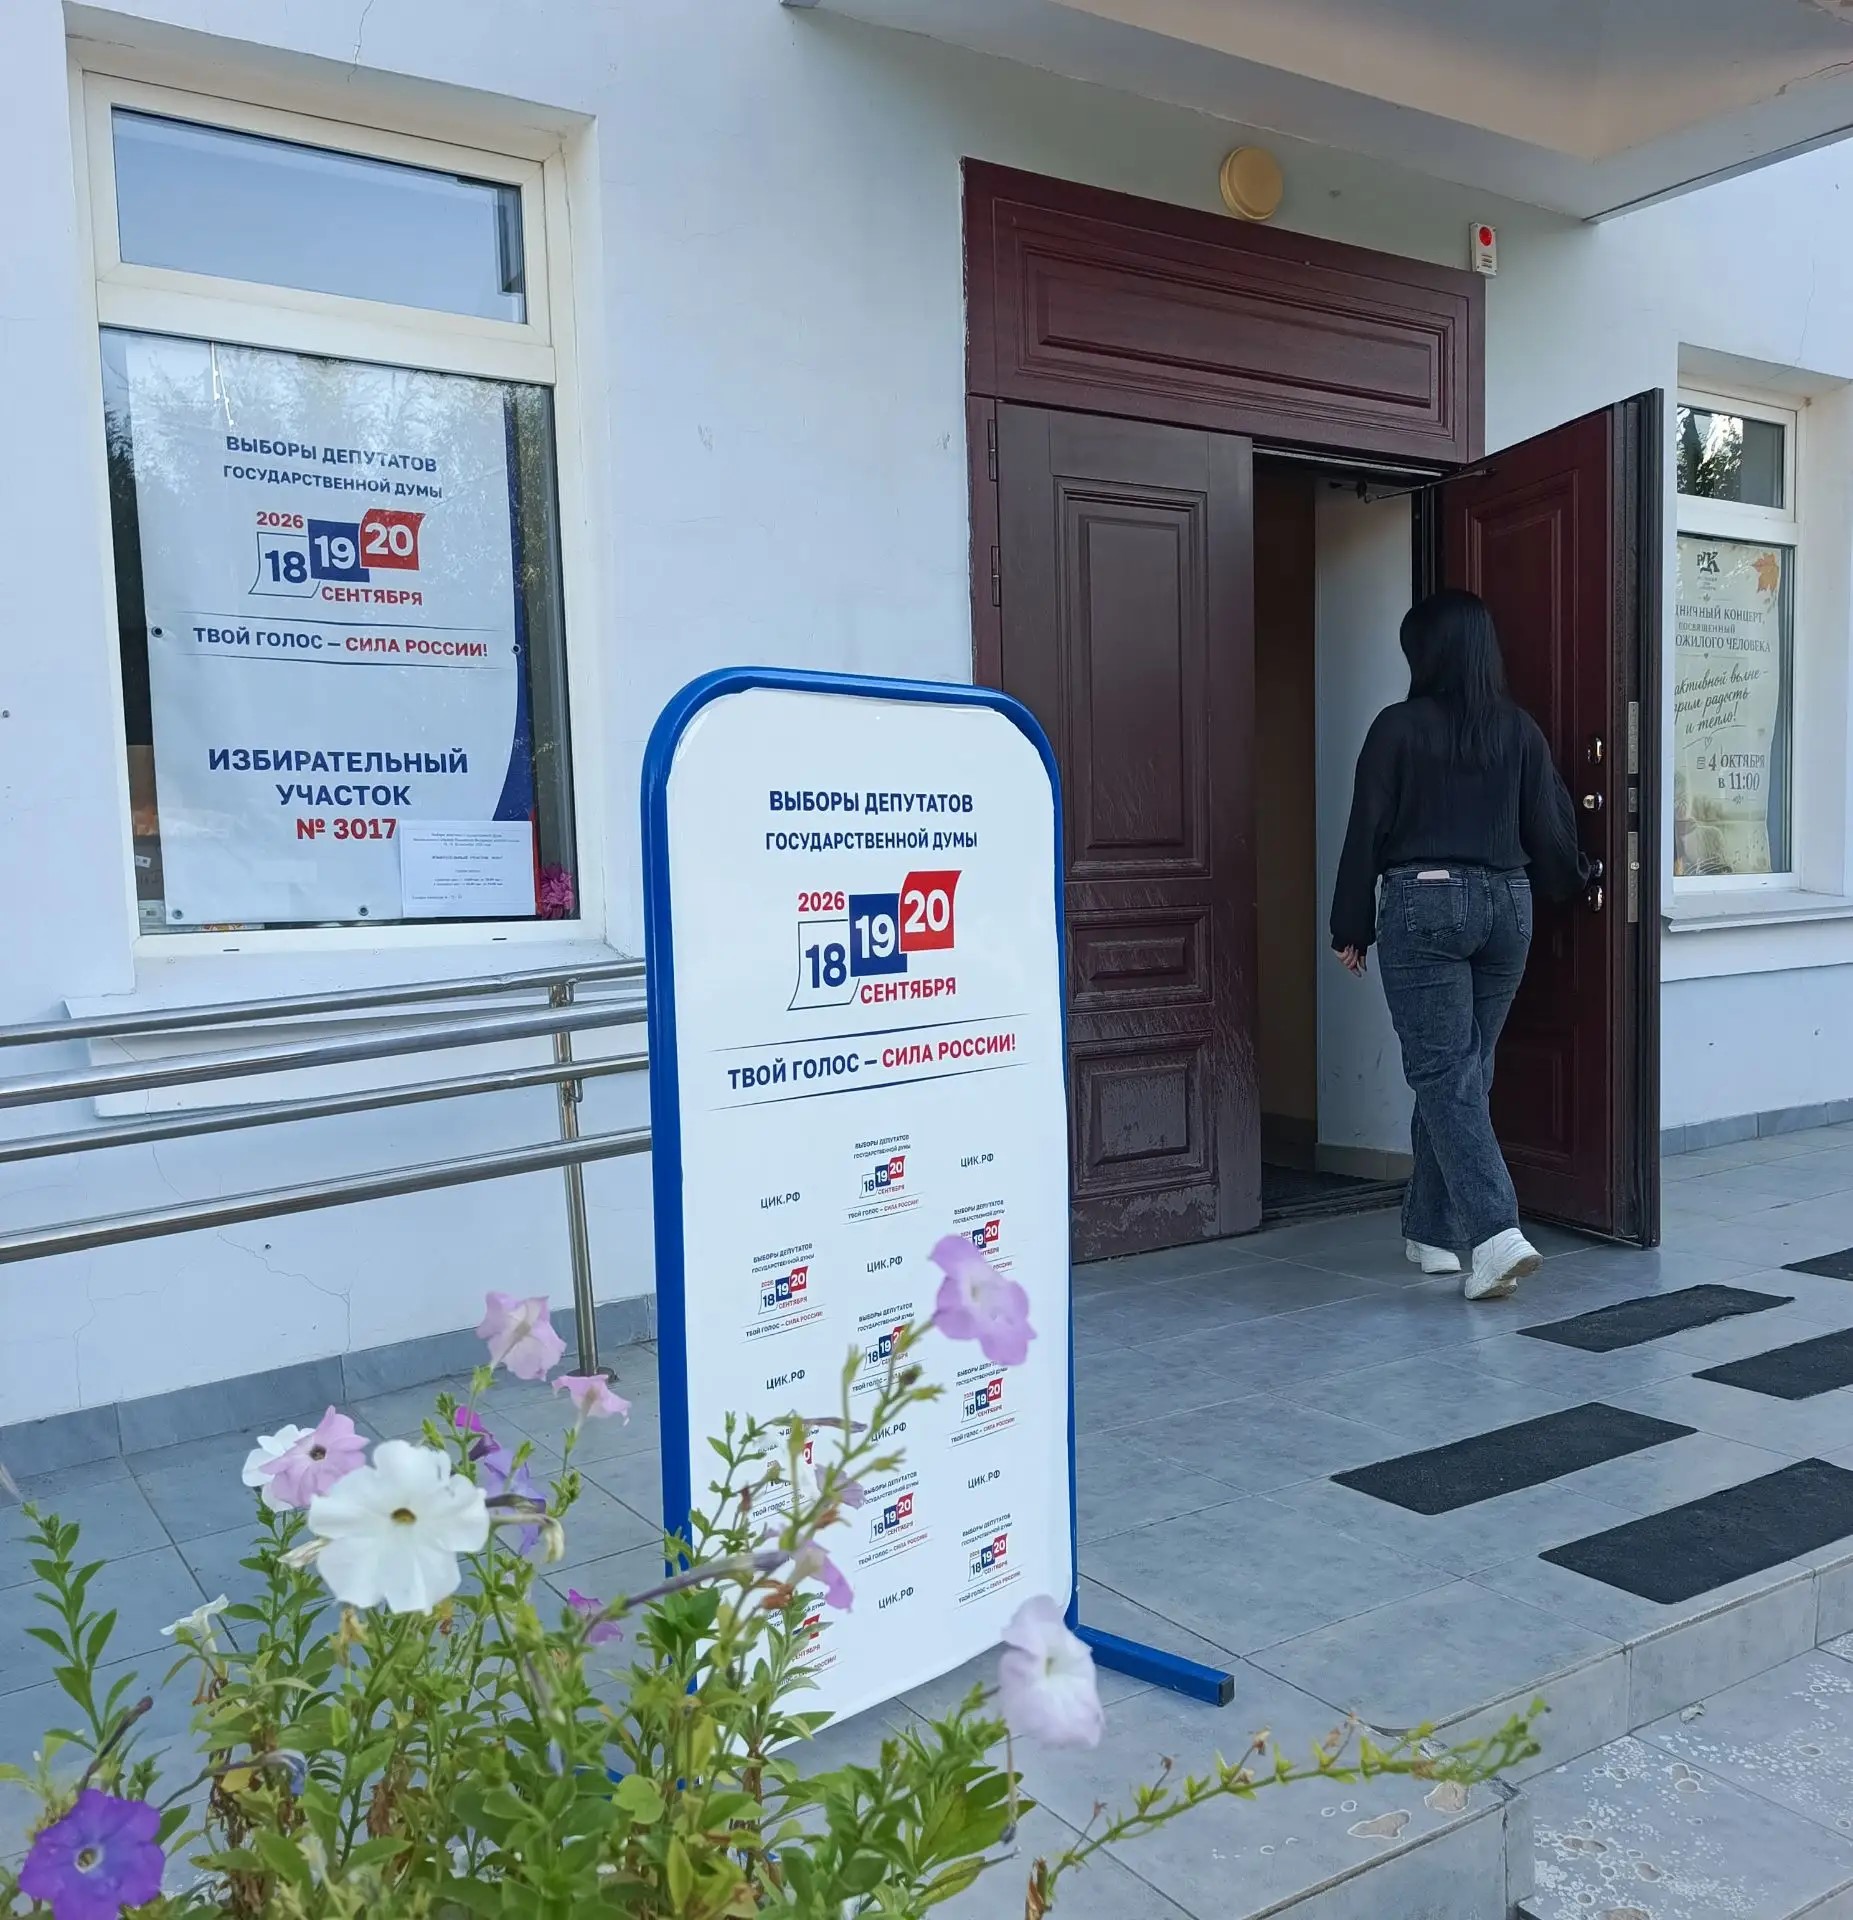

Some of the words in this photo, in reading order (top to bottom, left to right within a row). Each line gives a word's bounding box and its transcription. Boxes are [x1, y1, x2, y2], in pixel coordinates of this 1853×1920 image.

[226, 436, 317, 461] ВЫБОРЫ
[322, 447, 437, 473] ДЕПУТАТОВ
[223, 465, 390, 493] ГОСУДАРСТВЕННОЙ
[394, 480, 442, 499] ДУМЫ
[256, 511, 304, 529] 2026
[264, 550, 307, 583] 18
[314, 535, 354, 569] 19
[365, 523, 414, 555] 20
[321, 586, 423, 607] СЕНТЯБРЯ
[193, 624, 251, 645] ТВОЙ
[256, 631, 323, 649] ГОЛОС
[345, 636, 399, 654] СИЛА
[406, 639, 488, 657] РОССИИ!
[1726, 637, 1770, 652] ЧЕЛОВЕКА
[209, 746, 468, 772] ИЗБИРАТЕЛЬНЫЙ
[1709, 753, 1716, 771] 4
[1720, 754, 1765, 768] ОКТЯБРЯ
[1729, 772, 1759, 790] 11:00
[276, 785, 411, 806] УЧАСТОК
[769, 790, 859, 812] ВЫБОРЫ
[865, 793, 973, 815] ДЕПУТАТОВ
[297, 819, 325, 839] №
[333, 819, 397, 839] 3017
[766, 827, 928, 852] ГОСУДАРСТВЕННОЙ
[933, 831, 977, 850] ДУМЫ
[798, 891, 845, 912] 2026
[805, 943, 847, 988] 18
[855, 914, 896, 958] 19
[904, 889, 950, 933] 20
[860, 977, 956, 1004] СЕНТЯБРЯ
[728, 1058, 787, 1090] ТВОЙ
[792, 1053, 859, 1081] ГОЛОС
[882, 1042, 933, 1068] СИЛА
[938, 1033, 1016, 1061] РОССИИ!
[960, 1153, 994, 1168] ЦИК.РФ
[864, 1180, 874, 1192] 18
[876, 1169, 888, 1183] 19
[889, 1161, 903, 1175] 20
[760, 1191, 801, 1209] ЦИК.РФ
[974, 1234, 984, 1246] 19
[985, 1225, 998, 1238] 20
[866, 1255, 903, 1274] ЦИК.РФ
[762, 1294, 775, 1307] 18
[776, 1282, 789, 1297] 19
[791, 1272, 805, 1287] 20
[868, 1351, 878, 1363] 18
[880, 1340, 891, 1354] 19
[766, 1369, 806, 1390] ЦИК.РФ
[965, 1404, 975, 1416] 18
[977, 1393, 987, 1406] 19
[988, 1383, 1000, 1397] 20
[967, 1469, 1001, 1490] ЦИК.РФ
[873, 1522, 884, 1536] 18
[885, 1511, 896, 1525] 19
[898, 1499, 911, 1514] 20
[971, 1561, 981, 1575] 18
[982, 1551, 992, 1565] 19
[994, 1539, 1005, 1554] 20
[878, 1587, 914, 1610] ЦИК.РФ
